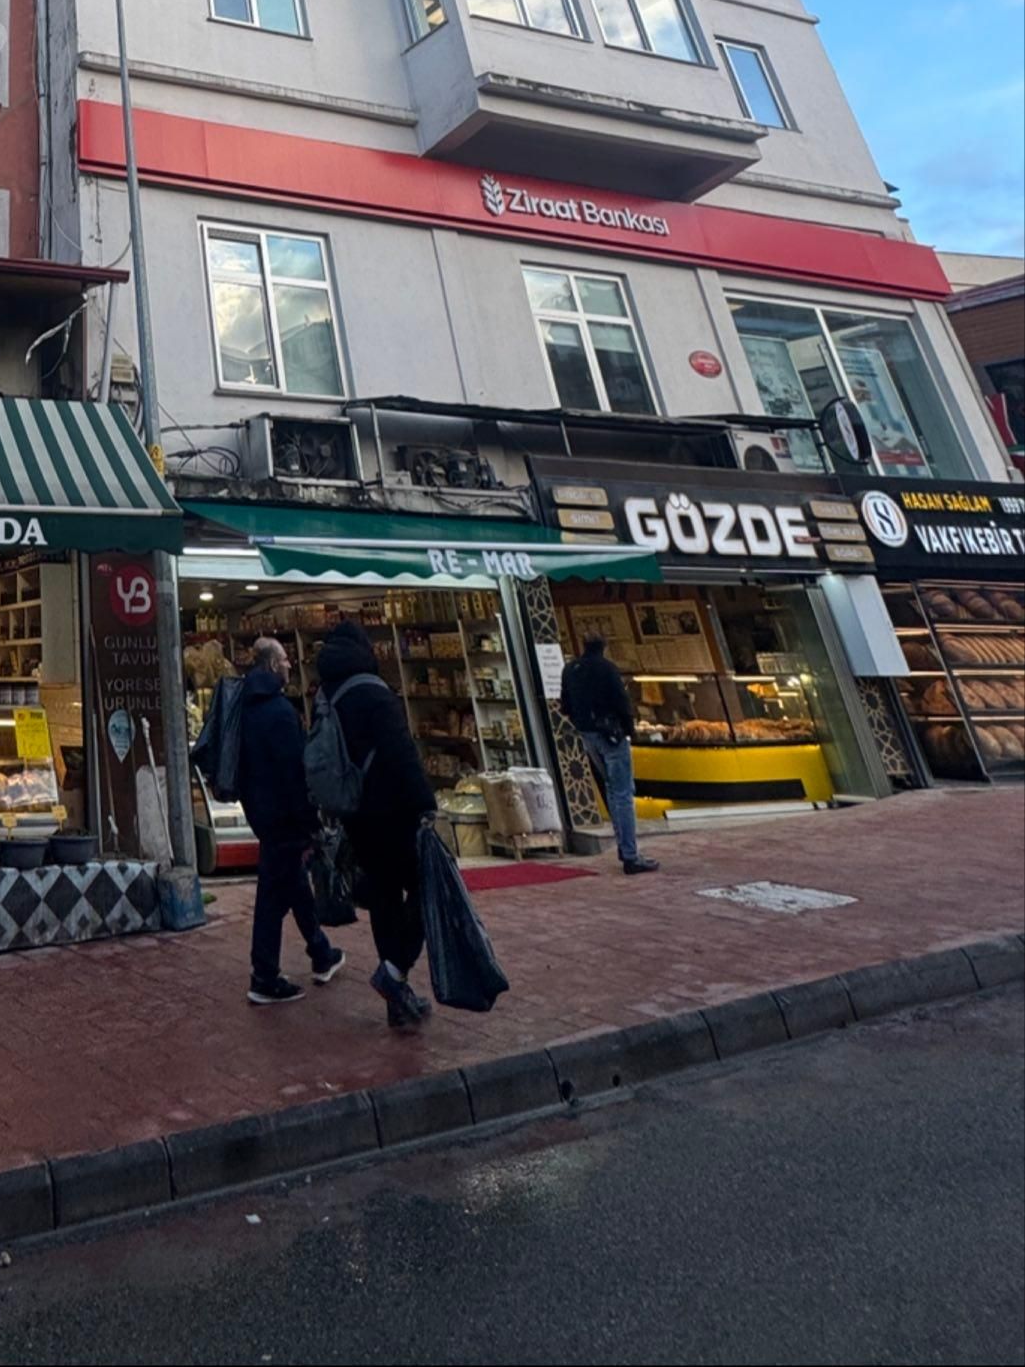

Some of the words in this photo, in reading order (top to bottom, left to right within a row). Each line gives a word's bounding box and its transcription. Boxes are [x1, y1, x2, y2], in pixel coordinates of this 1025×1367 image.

[506, 188, 580, 221] Ziraat
[580, 201, 670, 236] Bankası
[900, 491, 945, 511] HASAN
[943, 490, 993, 513] SAĞLAM
[625, 493, 818, 558] GÖZDE
[914, 520, 1018, 555] VAKFIKEBİR
